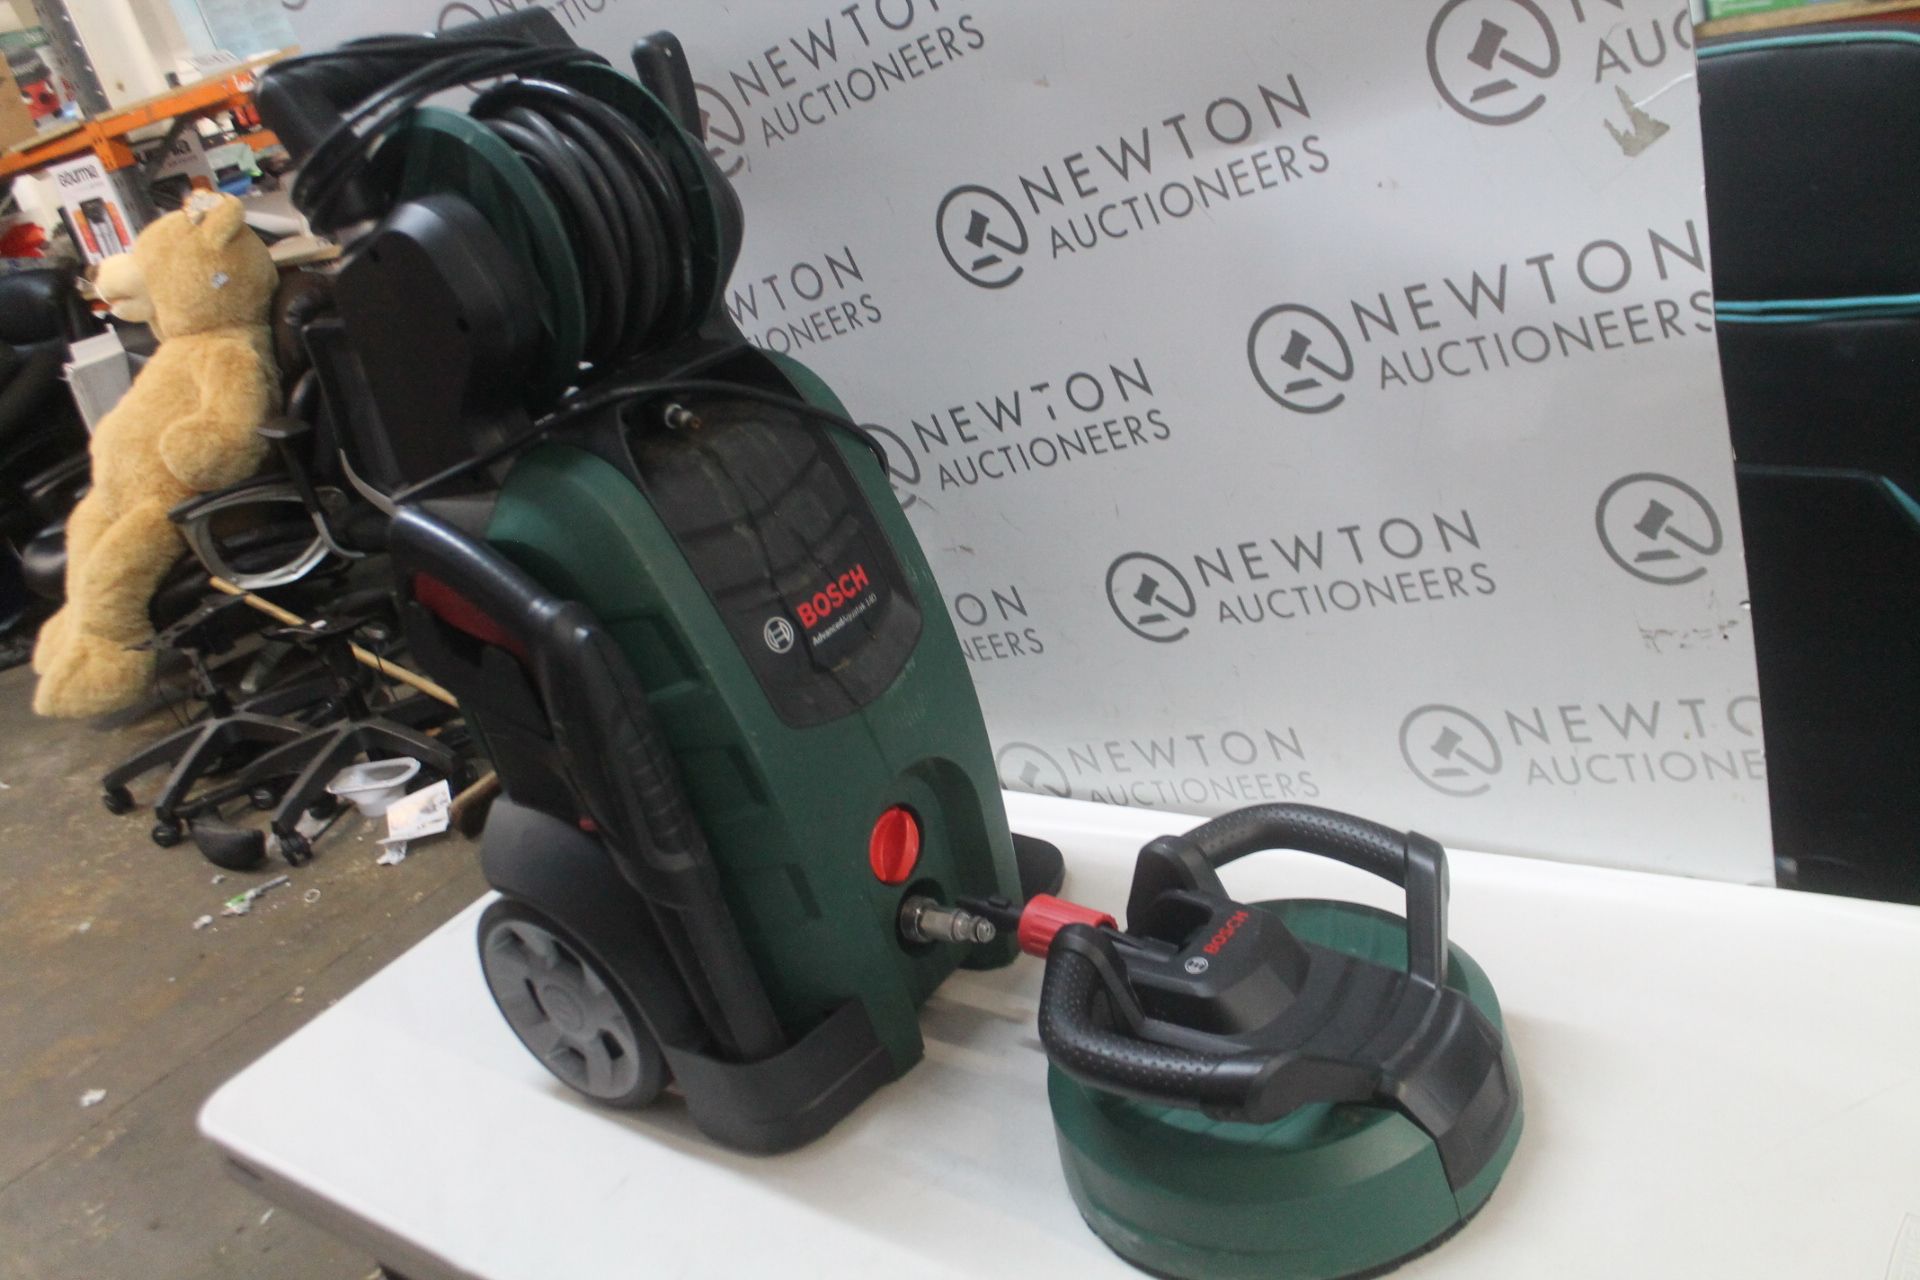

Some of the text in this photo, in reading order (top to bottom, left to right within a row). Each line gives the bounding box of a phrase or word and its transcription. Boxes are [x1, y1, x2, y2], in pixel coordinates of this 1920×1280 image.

[729, 0, 940, 106] NEWTO
[760, 14, 985, 148] AUCTIONEERS
[1018, 73, 1311, 215] NEWTON
[1050, 134, 1329, 259] AUCTIONEERS
[1350, 219, 1706, 342] NEWTON
[1380, 289, 1713, 390] AUCTIONEERS
[911, 357, 1154, 453] NEWTON
[939, 408, 1170, 491] AUCTIONEERS
[1193, 509, 1481, 588] NEWTON
[796, 563, 870, 630] BOSCH
[954, 584, 1028, 626] ON
[1219, 562, 1496, 625] AUCTIONEERS
[1067, 727, 1307, 775] NEWTON
[1091, 770, 1321, 806] AUCTIONEERS
[1203, 910, 1249, 957] BOSCH
